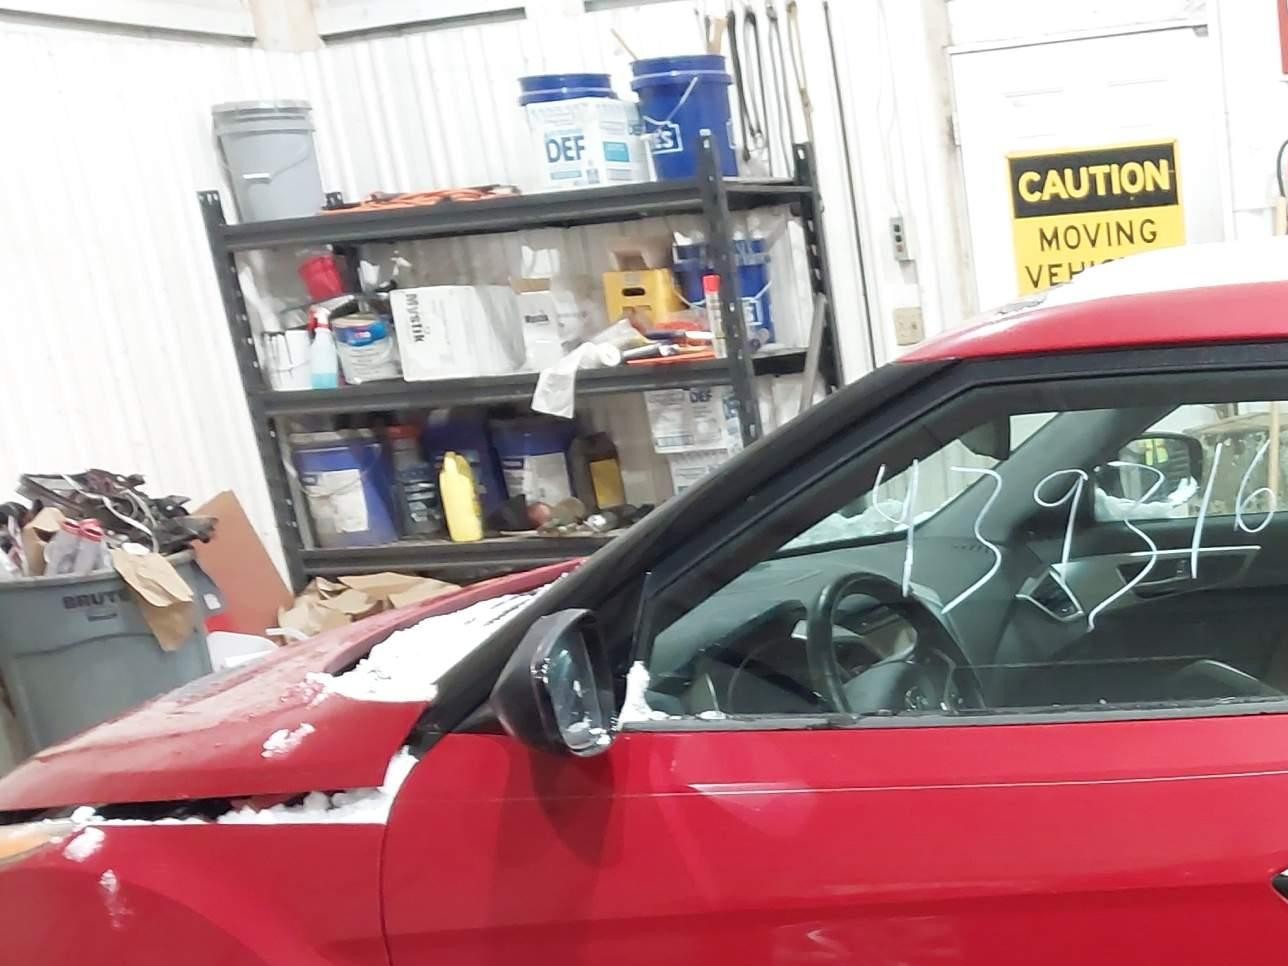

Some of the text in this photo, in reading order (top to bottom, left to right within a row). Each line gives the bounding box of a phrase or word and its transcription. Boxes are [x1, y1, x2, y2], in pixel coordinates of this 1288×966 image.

[545, 135, 585, 163] DEF
[1018, 158, 1171, 203] CAUTION
[1038, 218, 1157, 252] MOVING
